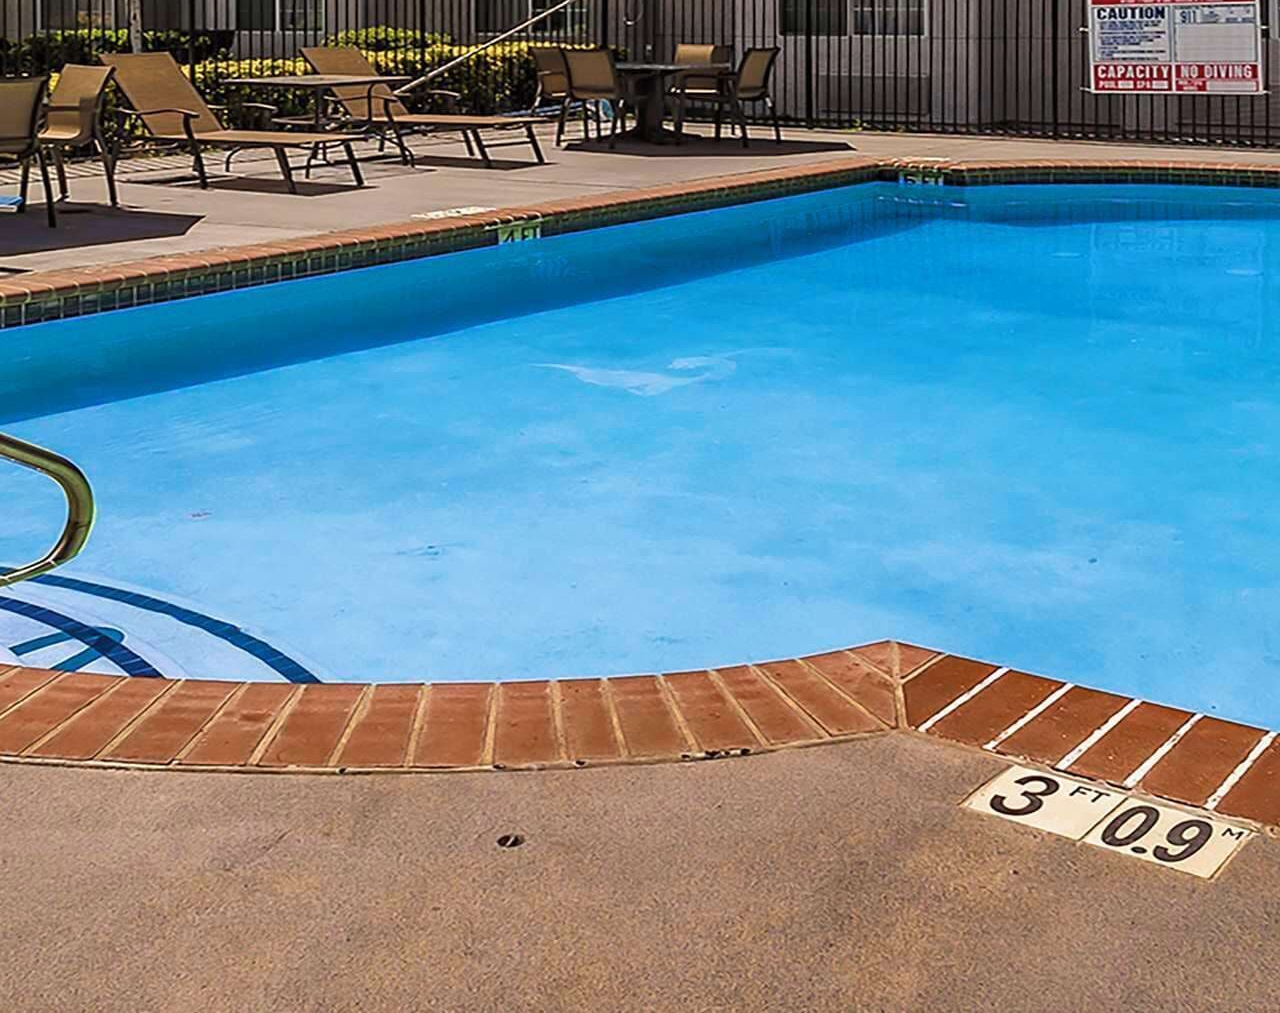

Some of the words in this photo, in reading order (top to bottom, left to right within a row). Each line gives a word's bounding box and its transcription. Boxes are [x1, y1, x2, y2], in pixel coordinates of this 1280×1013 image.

[1096, 7, 1166, 20] CAUTION
[1180, 10, 1197, 24] 911
[1097, 65, 1169, 79] CAPACITY
[1181, 65, 1198, 78] NO
[1204, 65, 1253, 78] DIVING
[989, 774, 1060, 817] 3
[1069, 786, 1112, 804] FT
[1100, 805, 1214, 863] 0.9
[1221, 828, 1246, 841] M
